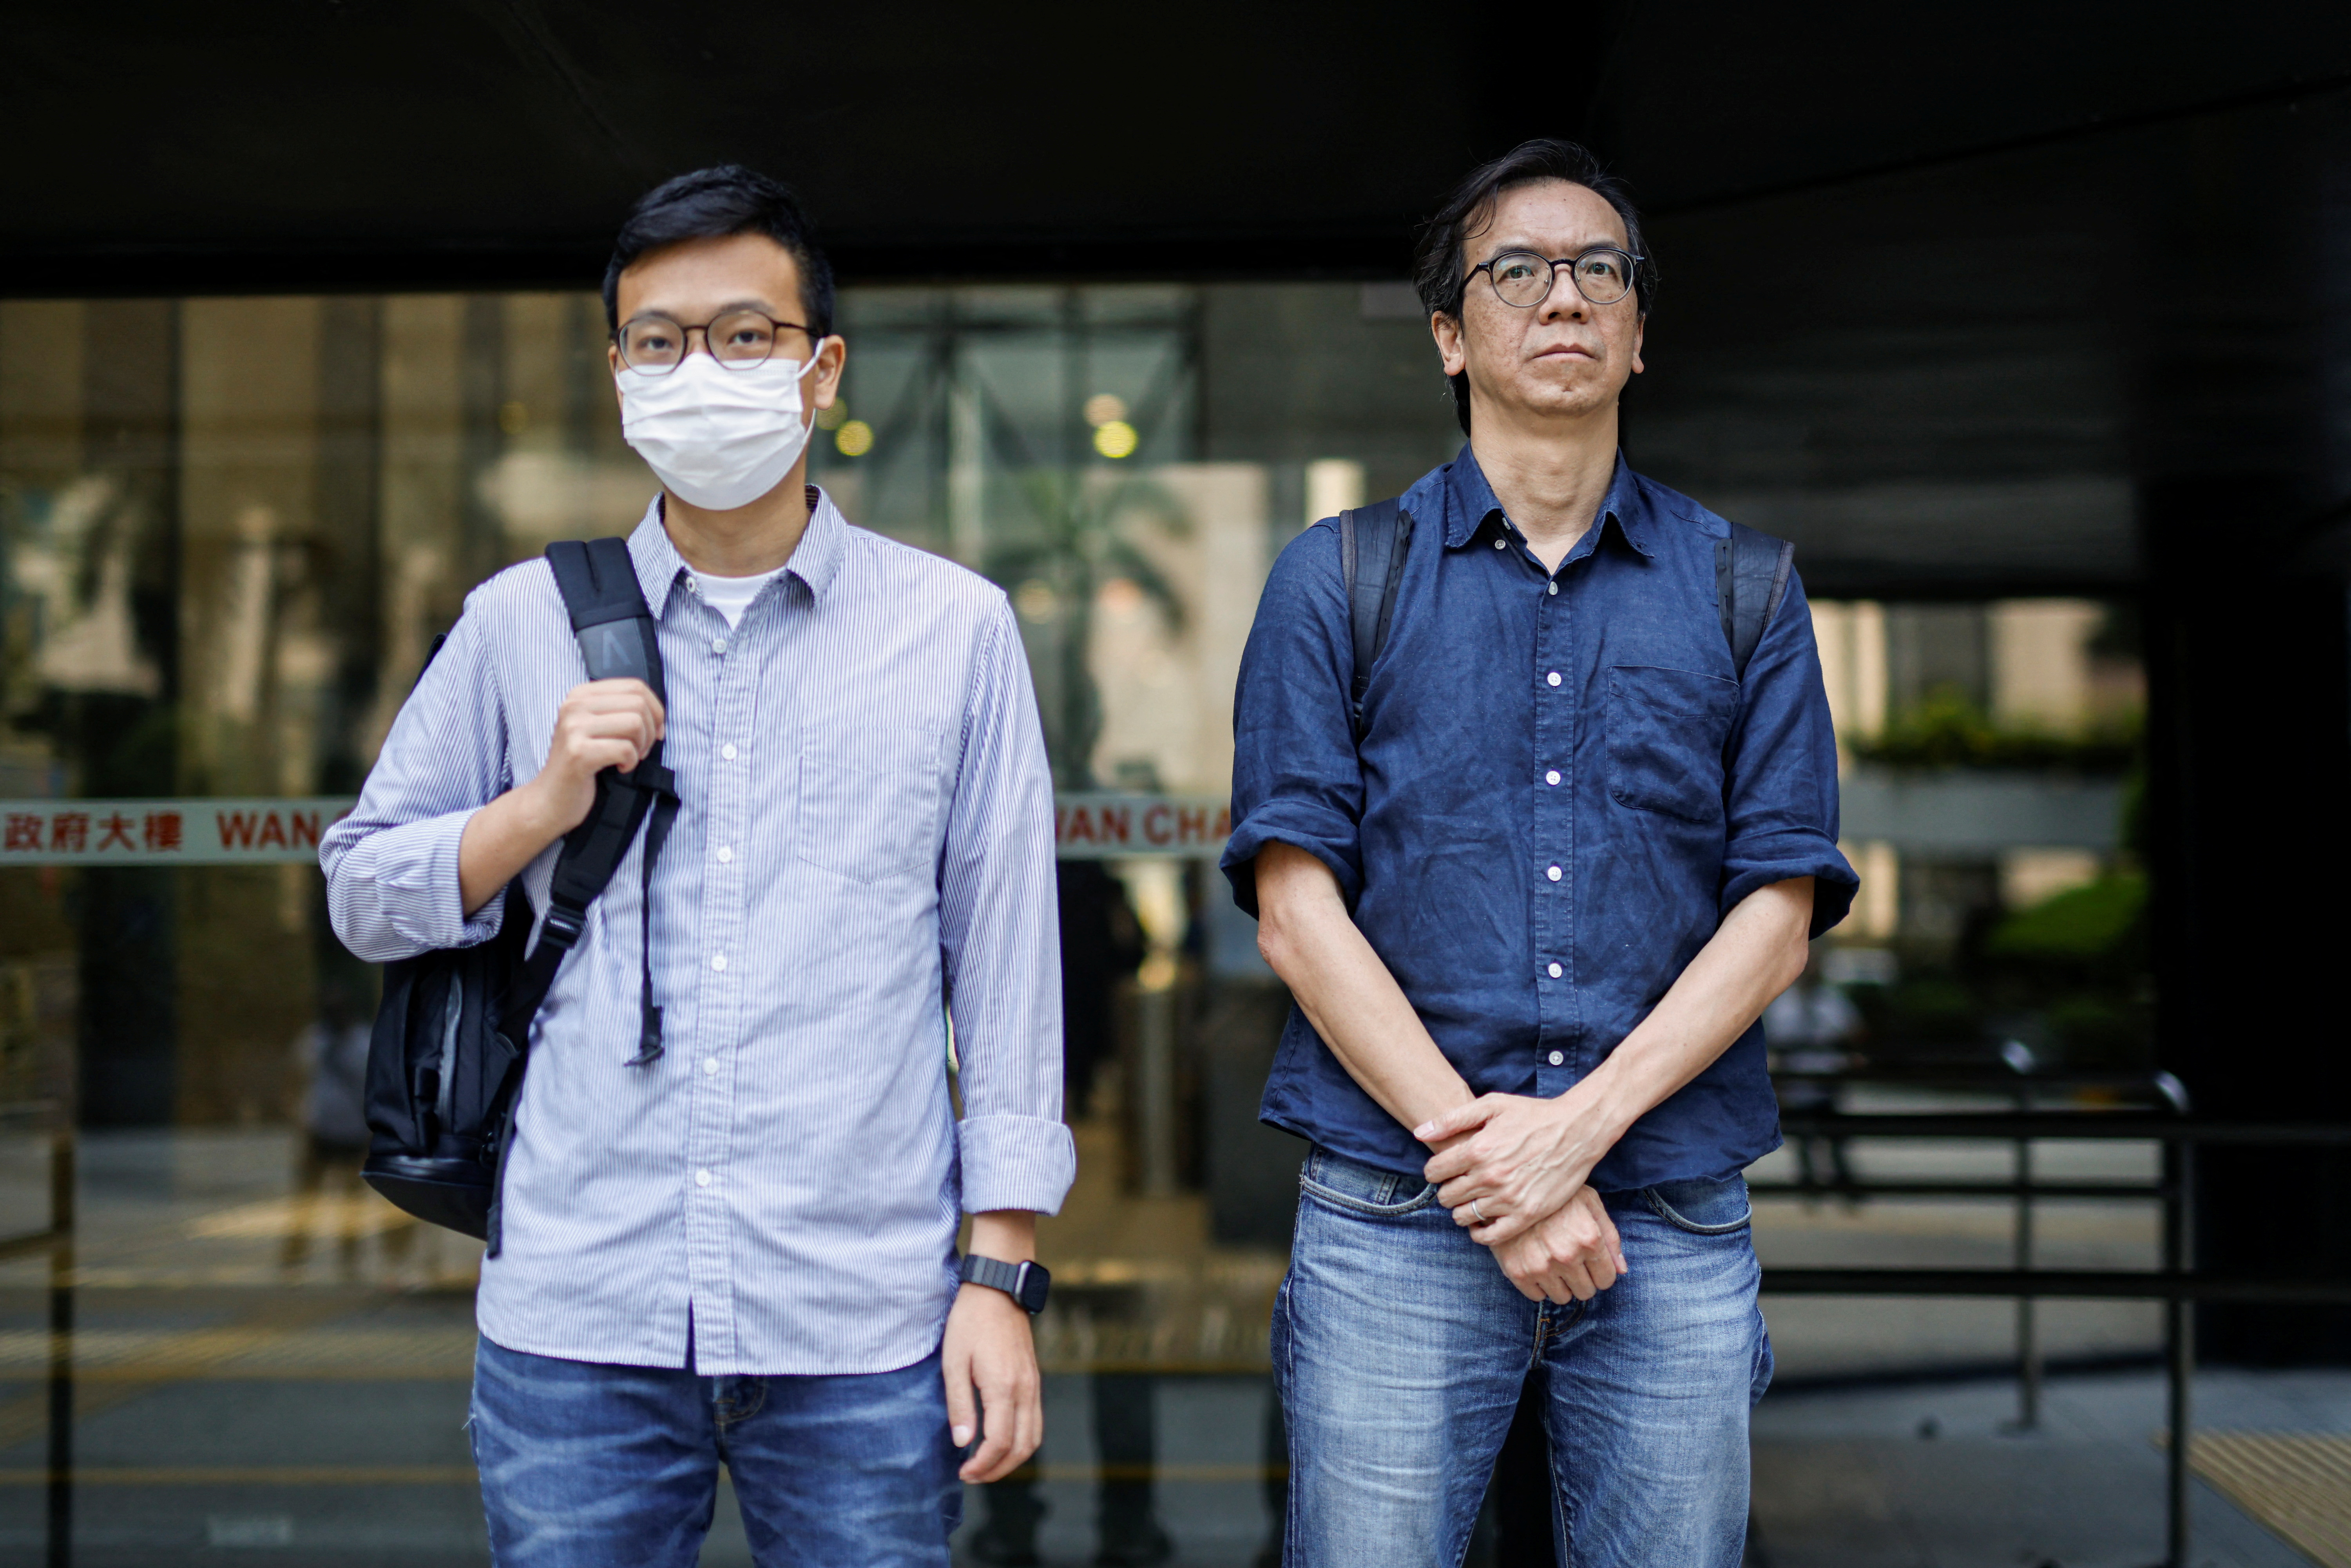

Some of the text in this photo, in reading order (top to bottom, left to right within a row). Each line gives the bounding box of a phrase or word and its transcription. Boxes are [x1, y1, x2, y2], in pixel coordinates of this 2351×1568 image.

[4, 811, 183, 852] 政府大樓
[216, 810, 320, 850] WAN
